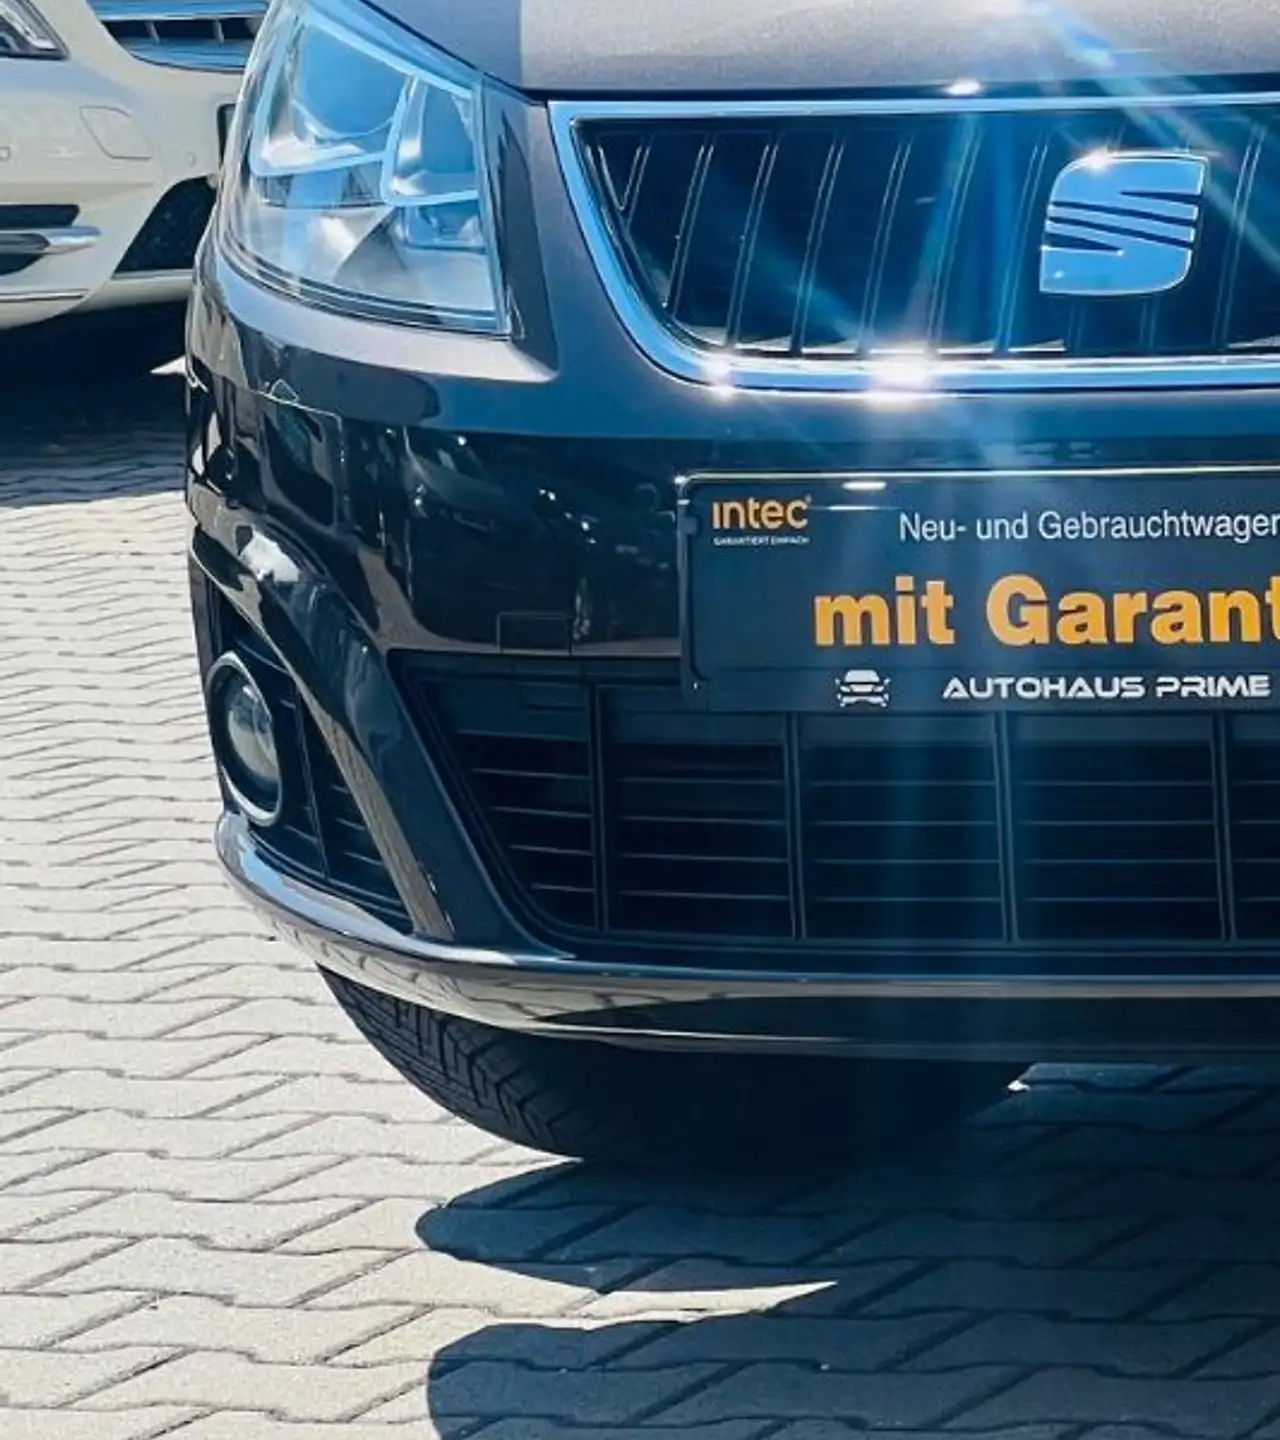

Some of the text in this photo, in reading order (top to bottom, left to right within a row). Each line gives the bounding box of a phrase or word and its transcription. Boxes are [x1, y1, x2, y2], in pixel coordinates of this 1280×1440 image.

[711, 497, 810, 530] intec
[899, 513, 967, 542] Neu-
[976, 509, 1029, 541] und
[813, 575, 955, 647] mit
[942, 673, 1271, 700] AUTOHAUS PRIME
